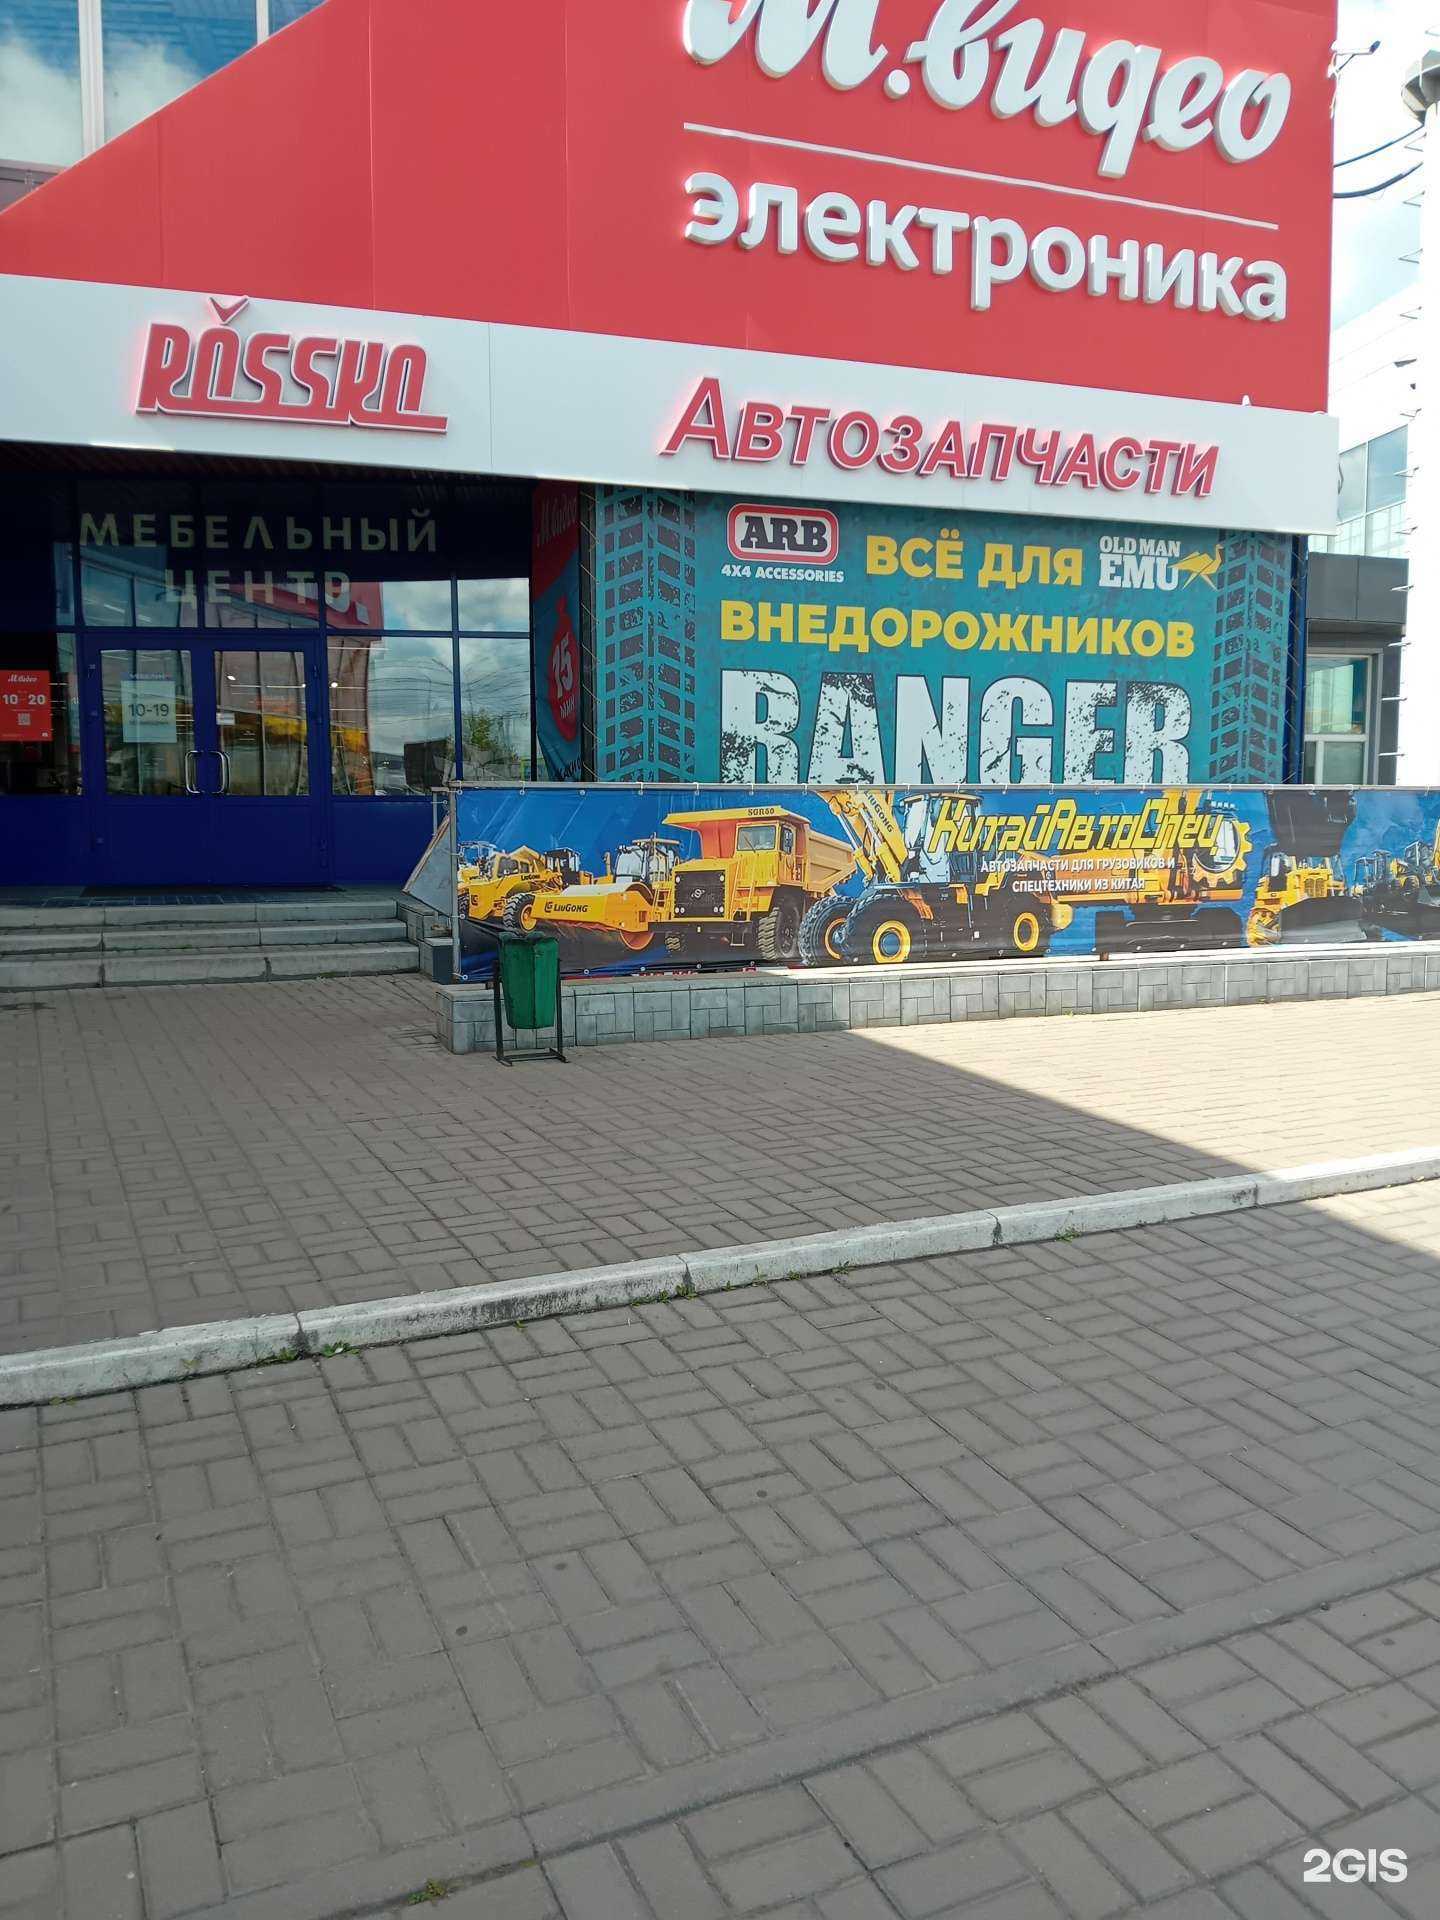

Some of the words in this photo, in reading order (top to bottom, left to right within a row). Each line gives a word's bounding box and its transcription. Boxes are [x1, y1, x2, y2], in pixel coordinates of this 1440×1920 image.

[684, 171, 1287, 321] электроника
[79, 508, 437, 552] МЕБЕЛЬНЫЙ
[740, 515, 829, 553] ARB
[1099, 535, 1136, 554] OLD
[1139, 538, 1181, 557] MAN
[721, 564, 751, 578] 4X4
[755, 566, 845, 583] ACCESSORIES
[866, 527, 965, 580] ВСЁ
[977, 543, 1083, 589] ДЛЯ
[1099, 552, 1181, 591] EMU
[163, 568, 351, 610] ЦЕНТР
[720, 600, 1196, 658] ВНЕДОРОЖНИКОВ
[2, 694, 19, 705] 10
[28, 694, 46, 705] 20
[128, 703, 169, 717] 10-19
[720, 668, 1192, 784] RANGER
[980, 858, 1070, 872] АВТОЗАПЧАСТИ
[1071, 859, 1094, 872] ДЛЯ
[1096, 857, 1166, 871] ГРУЗОВИКОВ
[1167, 857, 1175, 868] И
[1012, 878, 1092, 893] СПЕЦТЕХНИКИ
[1094, 878, 1109, 891] ИЗ
[1111, 876, 1146, 890] КИТАЯ
